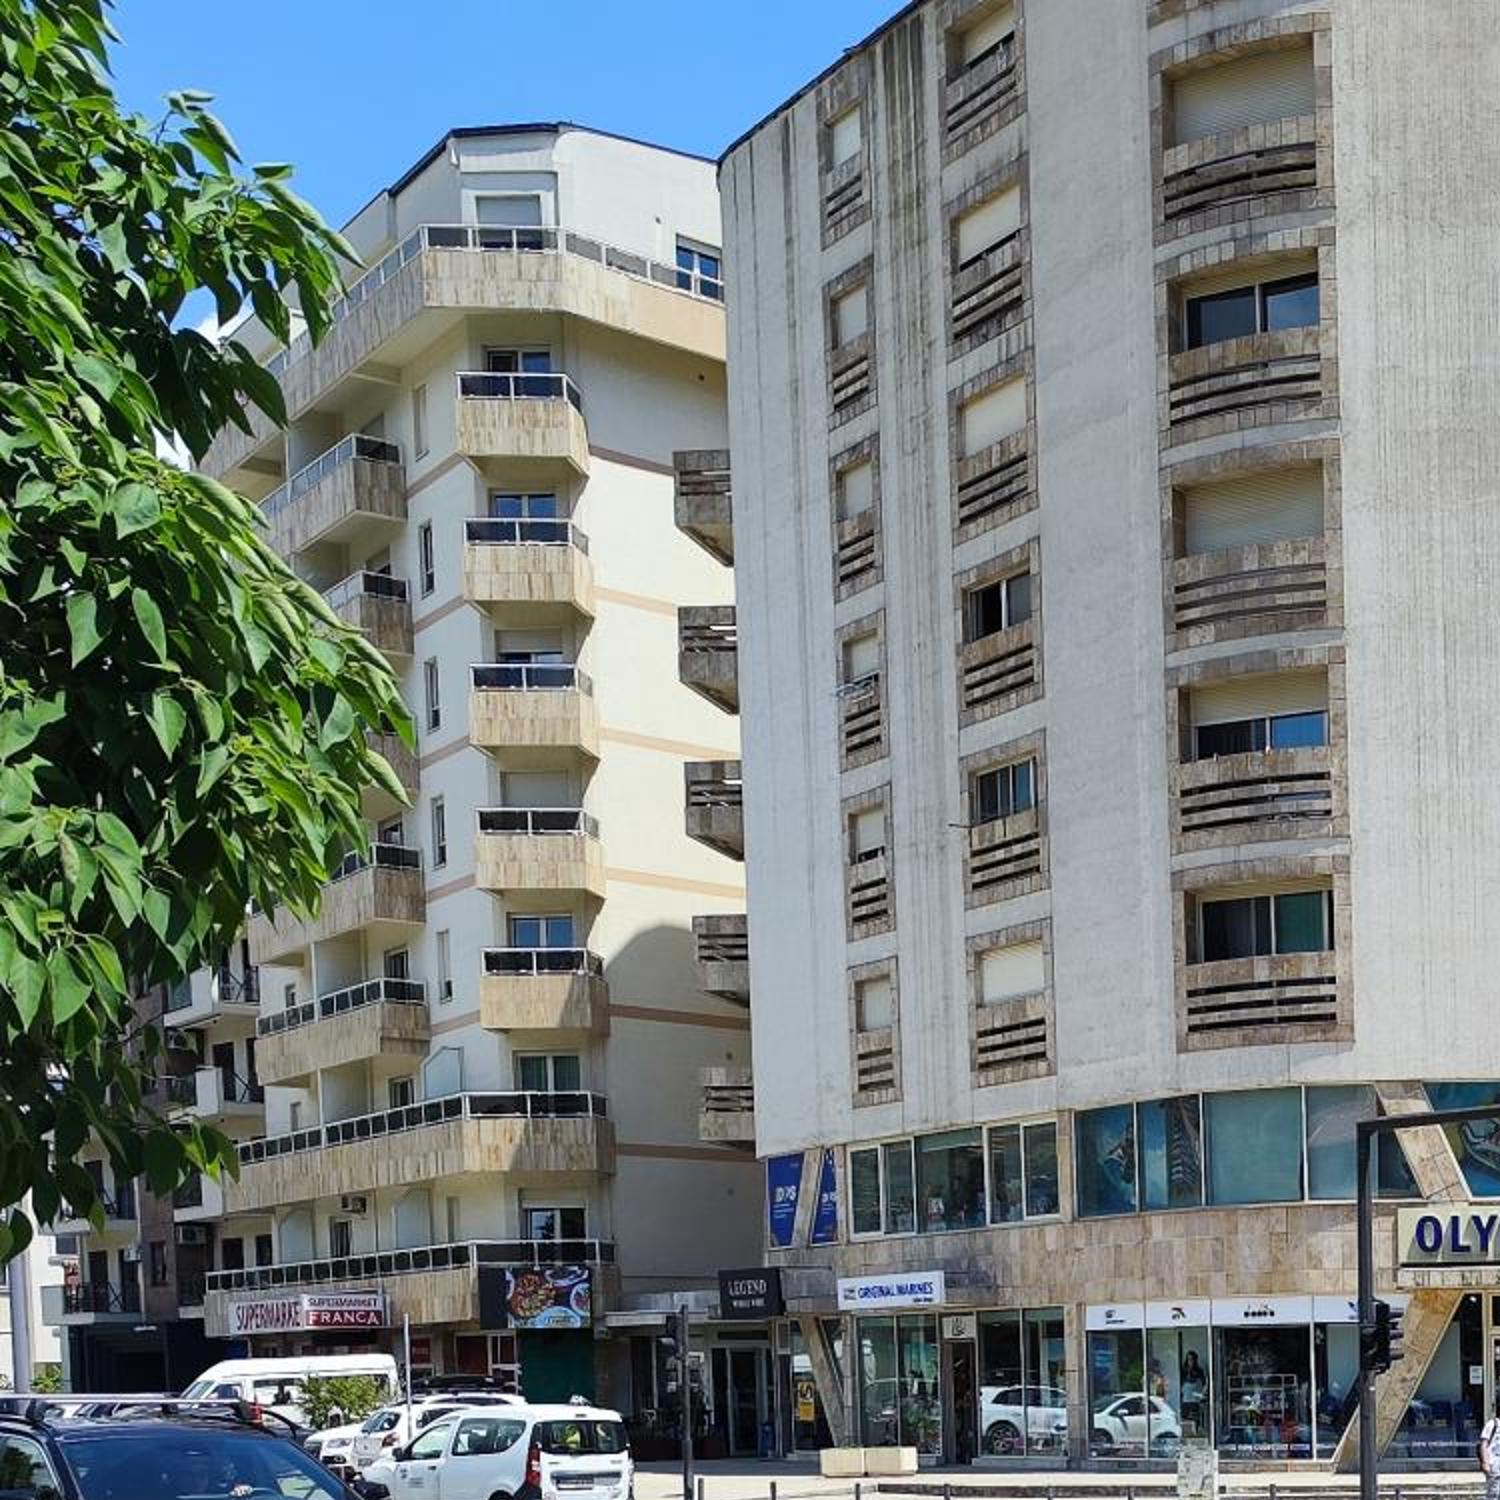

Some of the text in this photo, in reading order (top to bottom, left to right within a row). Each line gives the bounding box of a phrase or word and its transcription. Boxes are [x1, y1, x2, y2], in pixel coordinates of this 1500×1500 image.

[728, 1279, 767, 1297] LEGEND
[236, 1302, 300, 1331] SUPERMARKE
[309, 1311, 379, 1325] FRANCA
